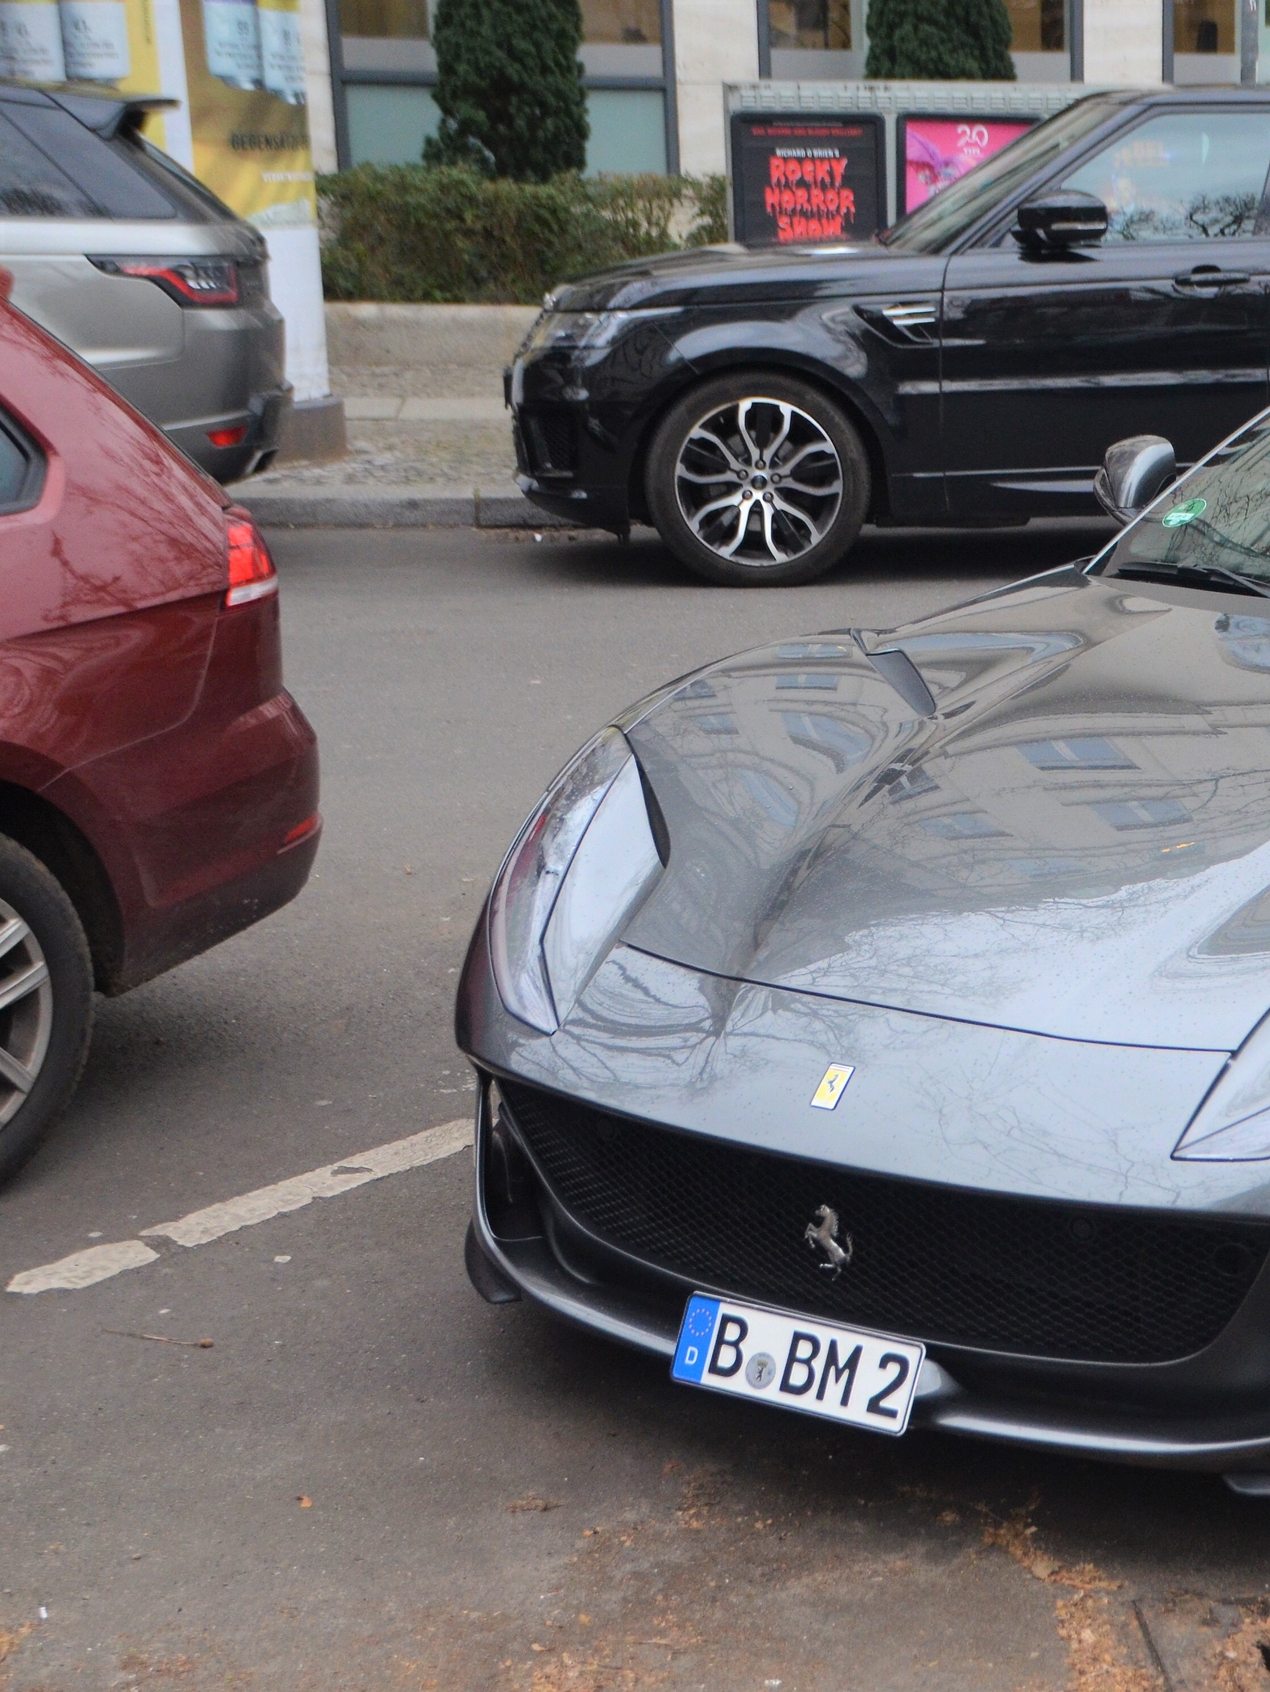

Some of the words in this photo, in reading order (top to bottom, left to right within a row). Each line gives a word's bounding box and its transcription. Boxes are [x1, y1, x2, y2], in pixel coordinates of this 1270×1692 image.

[775, 147, 806, 159] RICHARD
[769, 156, 848, 189] ROCKY
[764, 186, 855, 219] HORROR
[778, 214, 842, 242] SHOW
[685, 1346, 699, 1365] D
[708, 1312, 749, 1377] B
[779, 1330, 863, 1407] BM
[866, 1352, 910, 1419] 2
